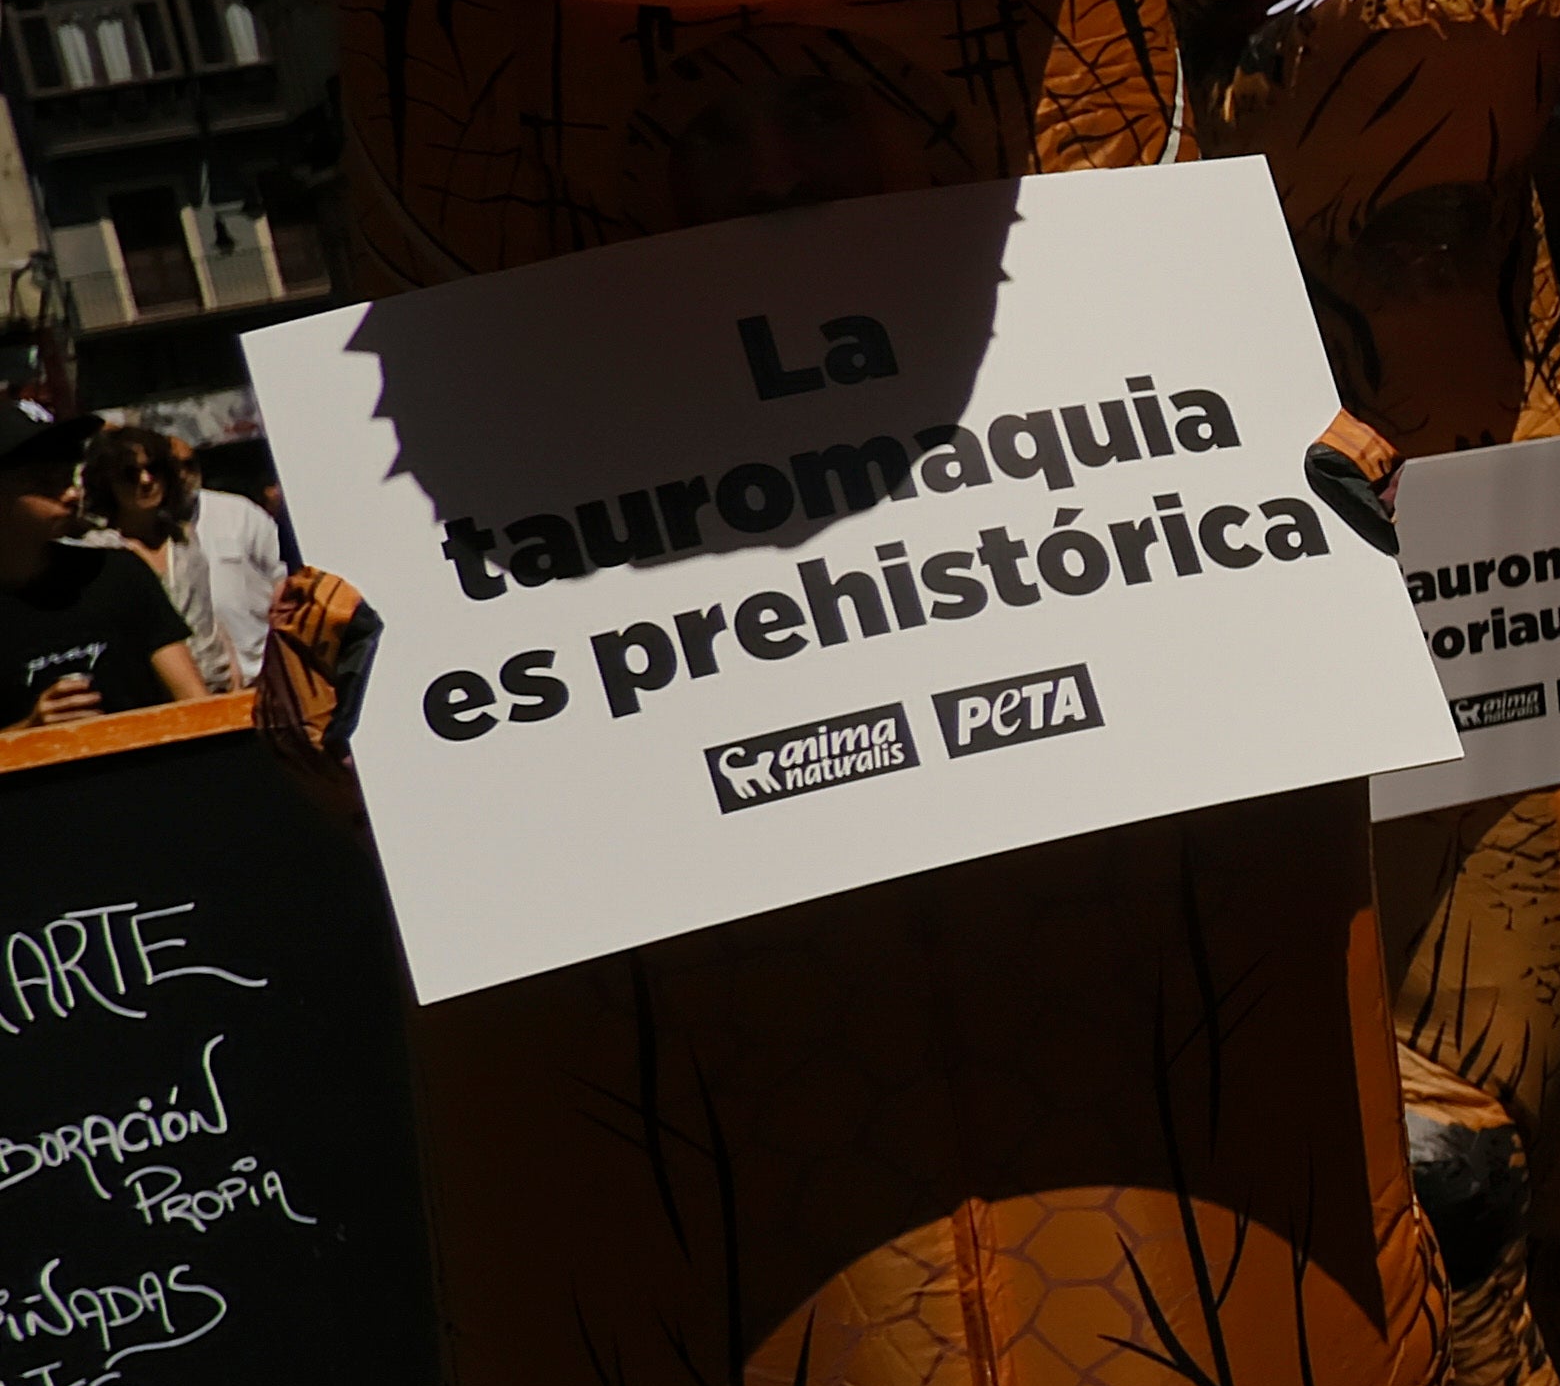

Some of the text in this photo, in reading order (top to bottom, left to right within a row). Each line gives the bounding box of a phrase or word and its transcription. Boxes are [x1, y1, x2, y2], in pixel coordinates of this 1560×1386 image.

[737, 313, 899, 402] La
[444, 374, 1242, 602] tauromaquia
[423, 490, 1331, 742] es prehistórica
[778, 715, 900, 768] anima
[783, 741, 907, 791] naturalis
